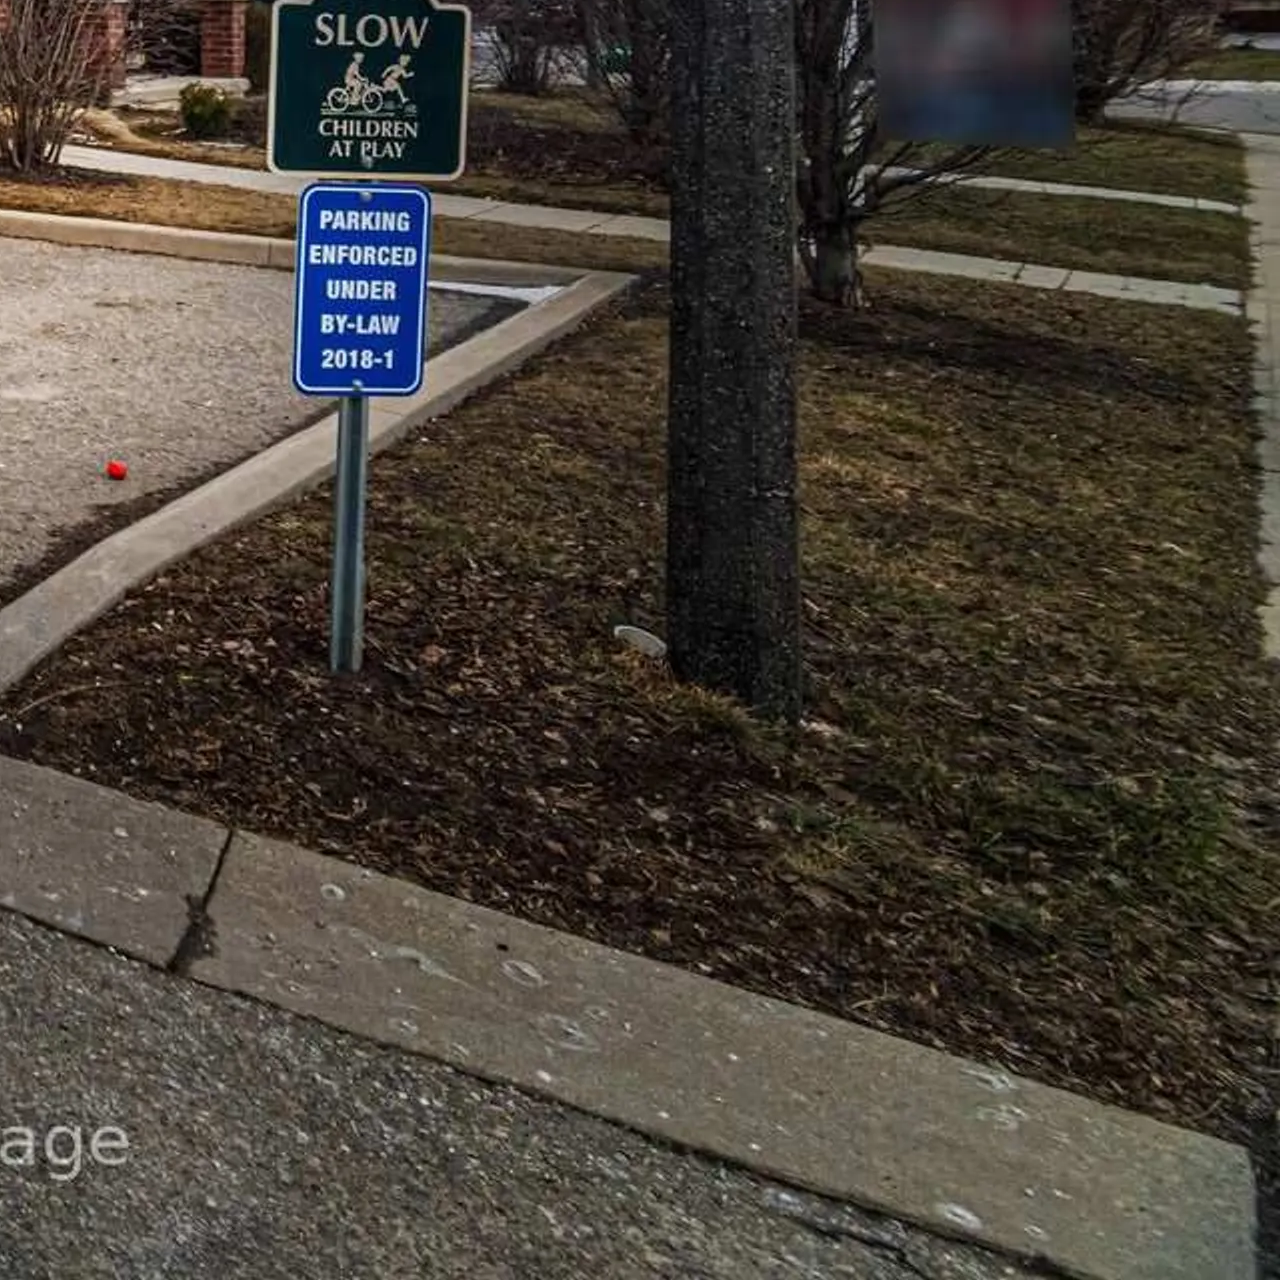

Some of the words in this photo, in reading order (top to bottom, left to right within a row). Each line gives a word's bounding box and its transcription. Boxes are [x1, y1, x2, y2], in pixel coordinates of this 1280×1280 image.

[315, 13, 429, 48] SLOW
[319, 119, 418, 138] CHILDREN
[329, 140, 353, 158] AT
[360, 140, 406, 159] PLAY
[320, 210, 410, 232] PARKING
[309, 244, 417, 266] ENFORCED
[326, 279, 396, 300] UNDER
[320, 314, 400, 335] BY-LAW
[321, 349, 395, 370] 2018-1
